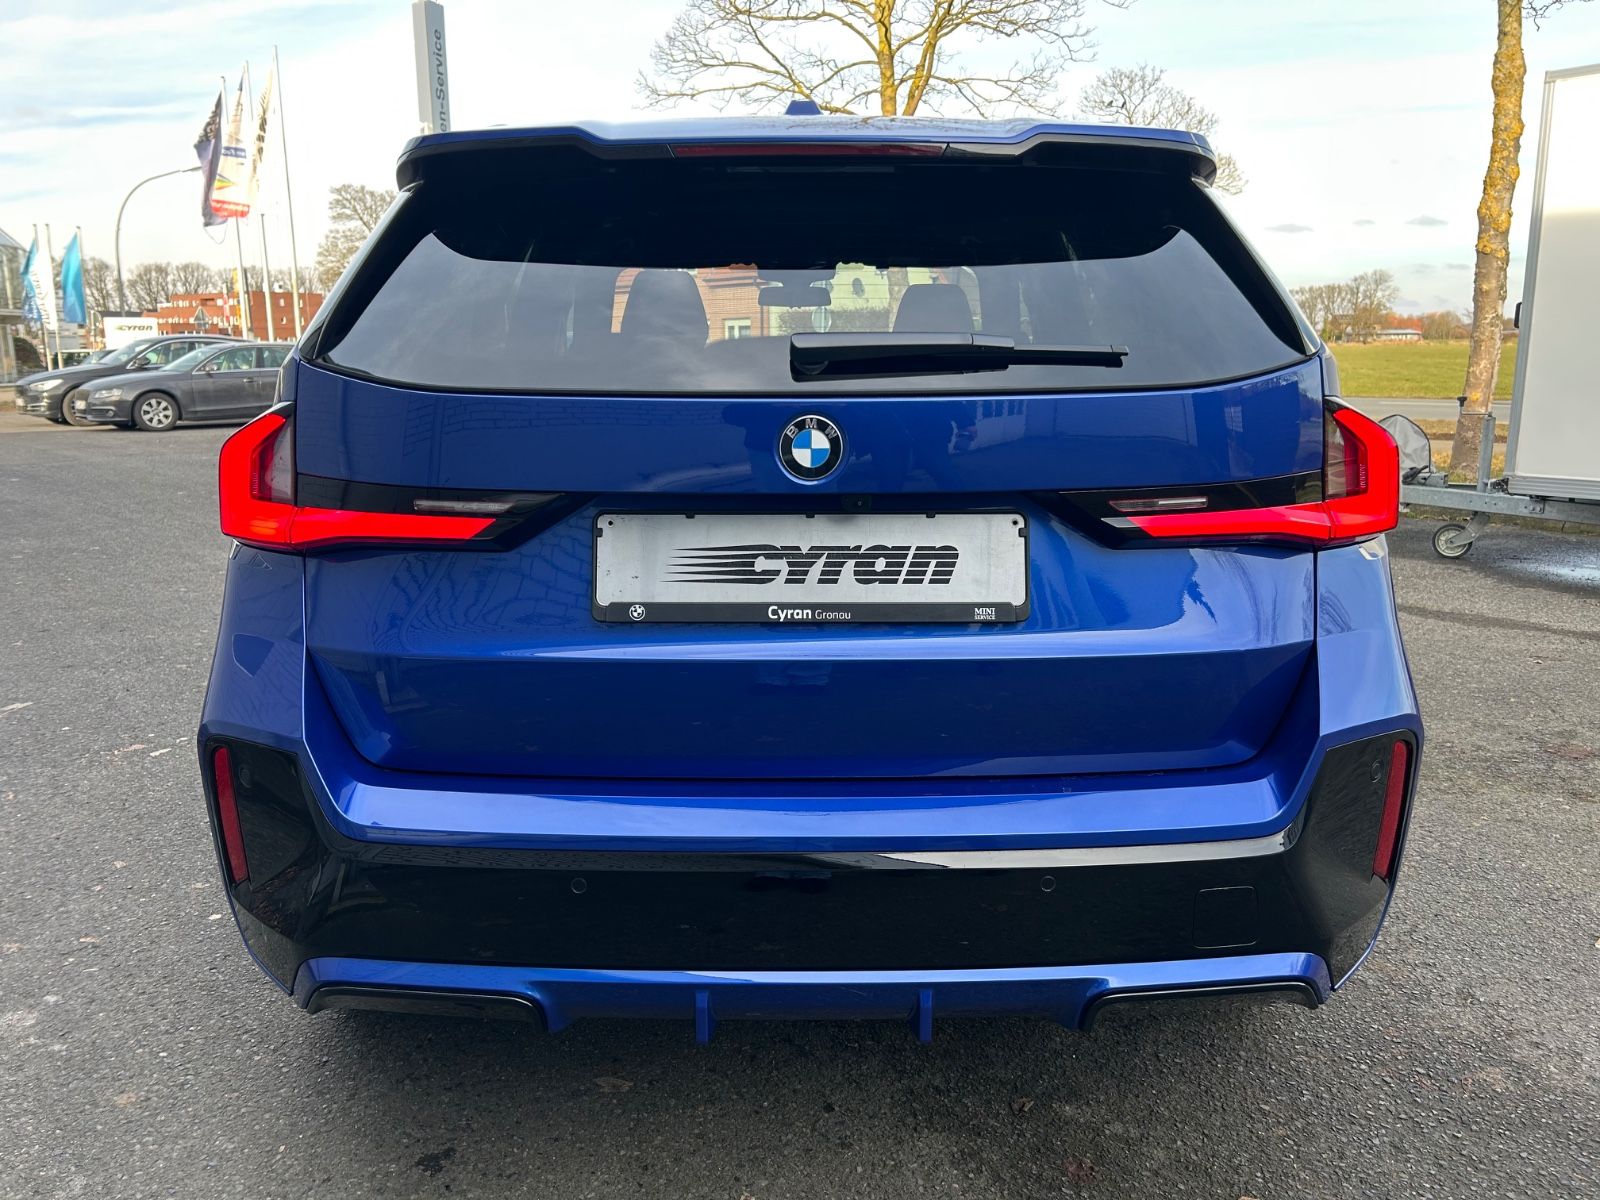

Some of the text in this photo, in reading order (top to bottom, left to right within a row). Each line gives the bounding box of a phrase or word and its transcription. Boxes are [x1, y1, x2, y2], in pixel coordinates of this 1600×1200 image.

[786, 418, 838, 439] BMW
[768, 605, 851, 622] Cyran Gronau
[974, 607, 996, 615] MINI
